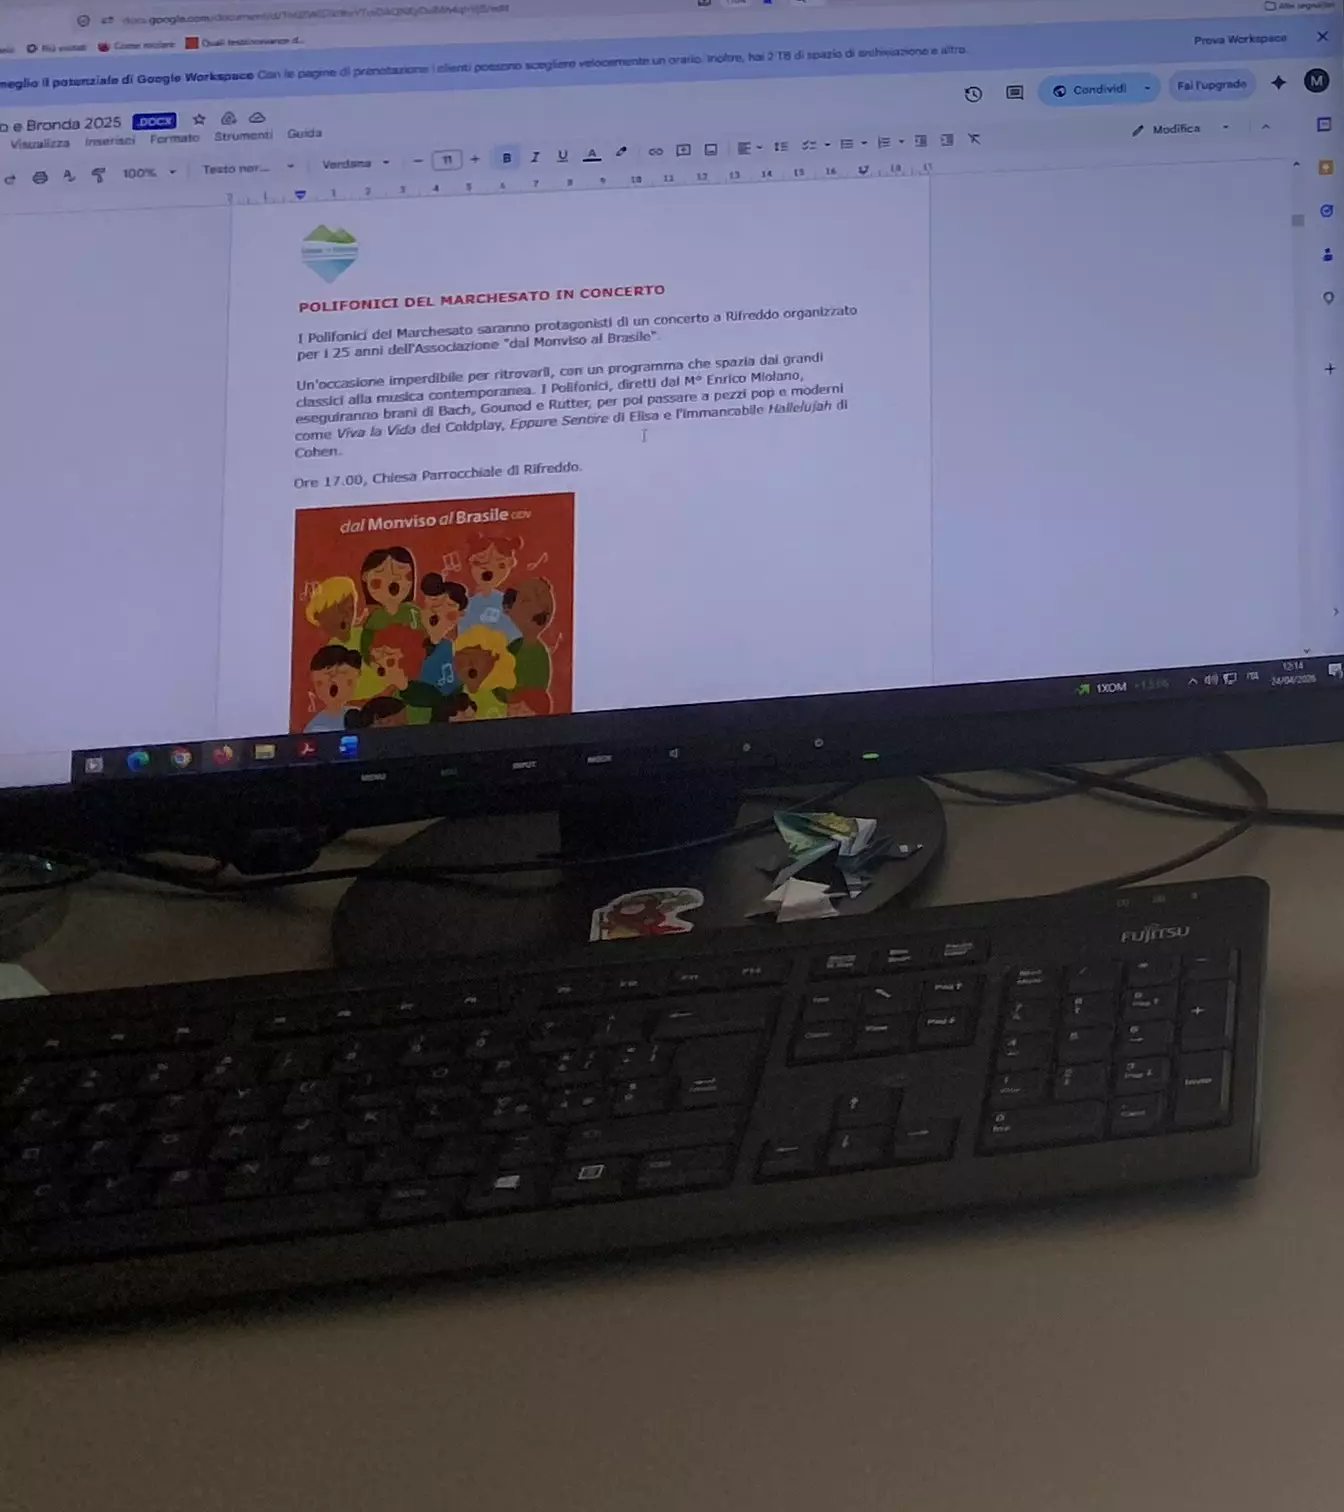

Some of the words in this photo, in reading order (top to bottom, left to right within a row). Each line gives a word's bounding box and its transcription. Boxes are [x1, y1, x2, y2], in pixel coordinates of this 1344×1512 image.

[1194, 35, 1225, 46] Prova
[1228, 32, 1288, 44] Workspace
[1073, 83, 1127, 95] Condividi
[1178, 82, 1194, 91] Fai
[1197, 78, 1247, 94] l'upgrade
[1153, 124, 1201, 135] Modifica
[299, 297, 399, 313] POLIFONICI
[404, 296, 434, 307] DEL
[441, 290, 550, 306] MARCHESATO
[556, 289, 574, 300] IN
[580, 284, 666, 300] CONCERTO
[298, 333, 303, 344] I
[308, 329, 367, 344] Polifonici
[372, 327, 393, 340] del
[397, 323, 473, 339] Marchesato
[477, 324, 530, 336] saranno
[534, 316, 612, 334] protagonisti
[617, 316, 629, 327] di
[633, 316, 649, 327] un
[654, 312, 709, 326] concerto
[713, 313, 722, 323] a
[726, 308, 779, 322] Rifreddo
[783, 304, 858, 321] organizzato
[297, 349, 318, 362] per
[332, 347, 350, 359] 25
[354, 344, 384, 357] anni
[388, 338, 499, 356] dell'Associazione
[503, 335, 529, 349] "dal
[533, 334, 587, 348] Monviso
[591, 332, 603, 345] al
[296, 376, 386, 392] Un'occasione
[389, 370, 464, 387] imperdibile
[468, 370, 489, 384] per
[494, 366, 555, 382] ritrovarli,
[559, 366, 583, 377] con
[587, 364, 604, 376] un
[608, 360, 684, 377] programma
[688, 358, 711, 370] che
[714, 354, 756, 370] spazia
[759, 353, 780, 366] dai
[782, 351, 824, 367] grandi
[294, 446, 343, 459] Cohen.
[294, 477, 319, 489] Ore
[324, 474, 368, 489] 17.00,
[372, 471, 418, 485] Chiesa
[422, 466, 502, 482] Parrocchiale
[507, 464, 520, 477] di
[523, 462, 582, 477] Rifreddo.
[340, 519, 365, 534] dal
[368, 515, 436, 531] Monviso
[439, 512, 454, 526] al
[455, 508, 509, 524] Brasile
[1120, 922, 1190, 944] FUJITSU
